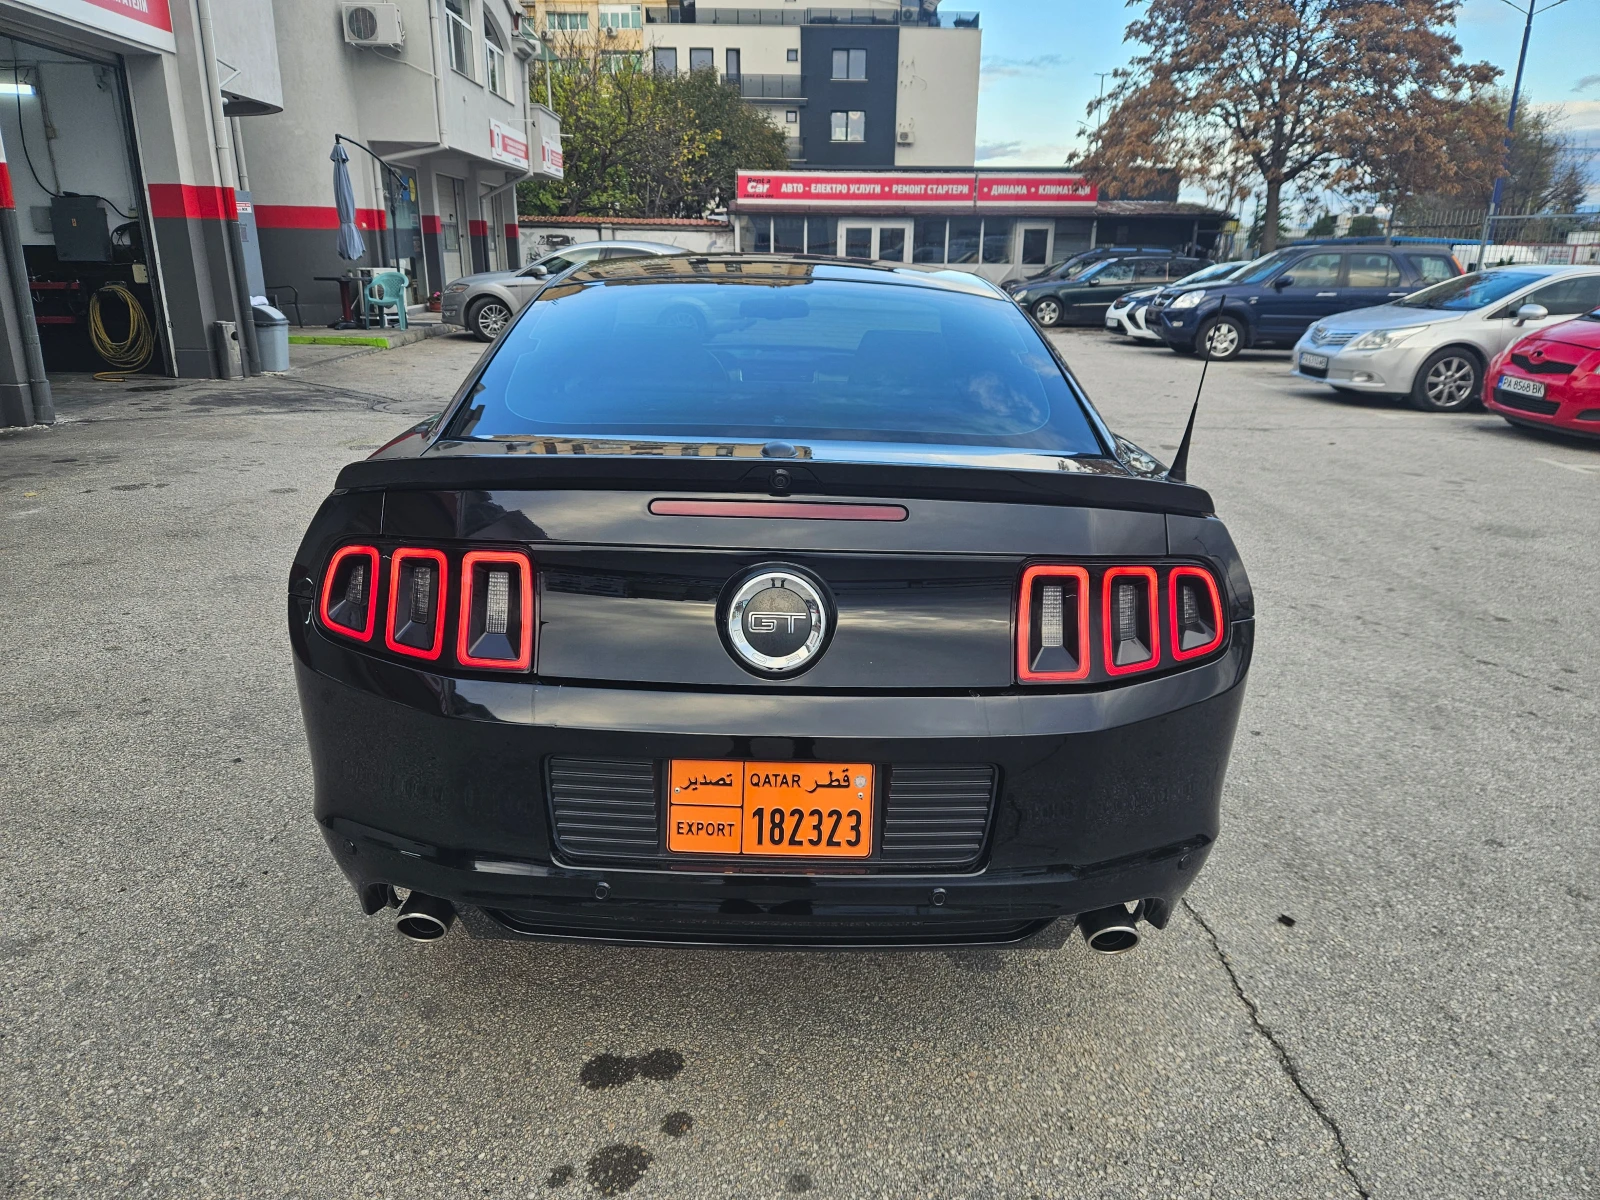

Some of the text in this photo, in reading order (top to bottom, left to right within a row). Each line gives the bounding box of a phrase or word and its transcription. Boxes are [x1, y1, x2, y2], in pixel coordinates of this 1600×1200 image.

[746, 182, 770, 193] Car
[781, 183, 804, 194] АВТО
[811, 183, 848, 194] ЕЛЕКТРО
[849, 183, 881, 194] УСЛУГИ
[892, 184, 926, 194] РЕМОНТ
[927, 184, 969, 194] СТАРТЕРИ
[990, 185, 1027, 196] ДИНАМА
[1502, 377, 1543, 395] PA 8568 BK
[748, 611, 807, 634] GT
[680, 773, 733, 791] تصدير
[750, 773, 801, 788] QATAR
[805, 768, 850, 793] قطر
[676, 821, 736, 837] EXPORT
[752, 807, 862, 847] 182323
